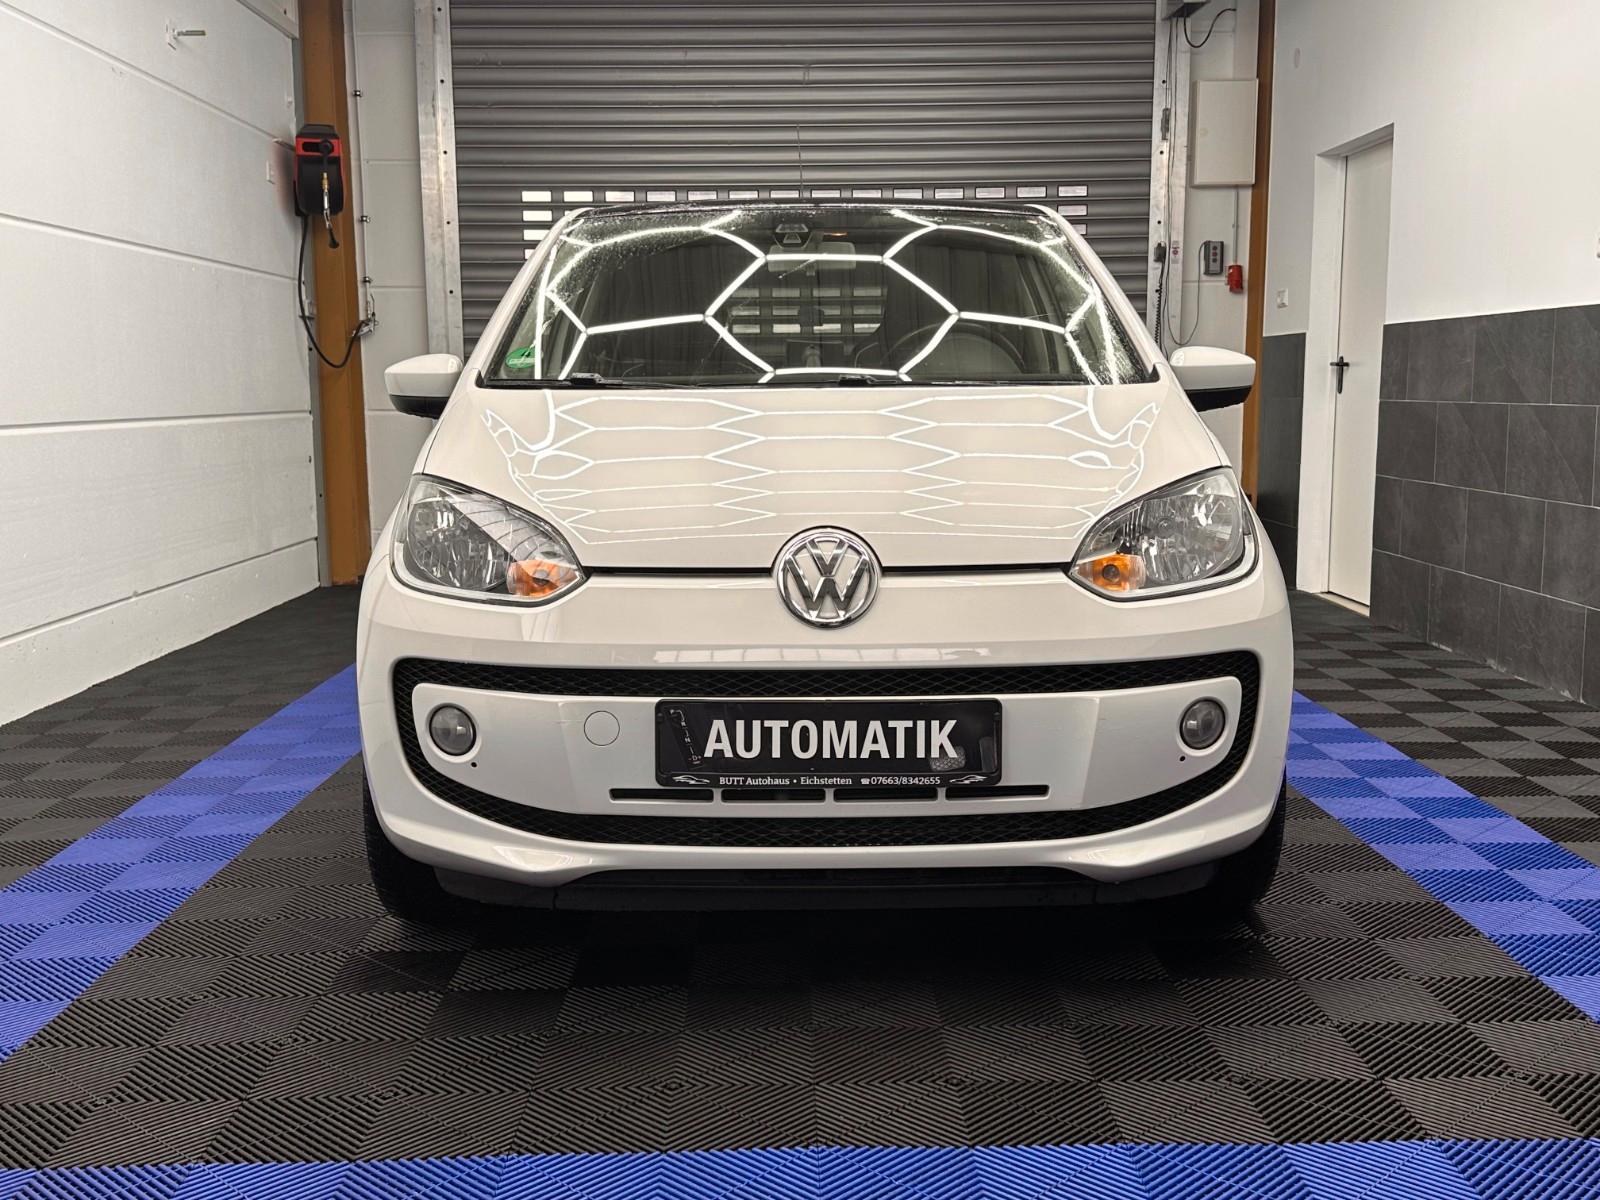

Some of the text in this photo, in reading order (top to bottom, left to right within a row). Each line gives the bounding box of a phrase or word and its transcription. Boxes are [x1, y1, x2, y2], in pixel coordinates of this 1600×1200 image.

[783, 536, 872, 622] VW
[704, 719, 958, 760] AUTOMATIK
[719, 776, 941, 786] BUTT Autohaus Eichstetten 07663/8342655
